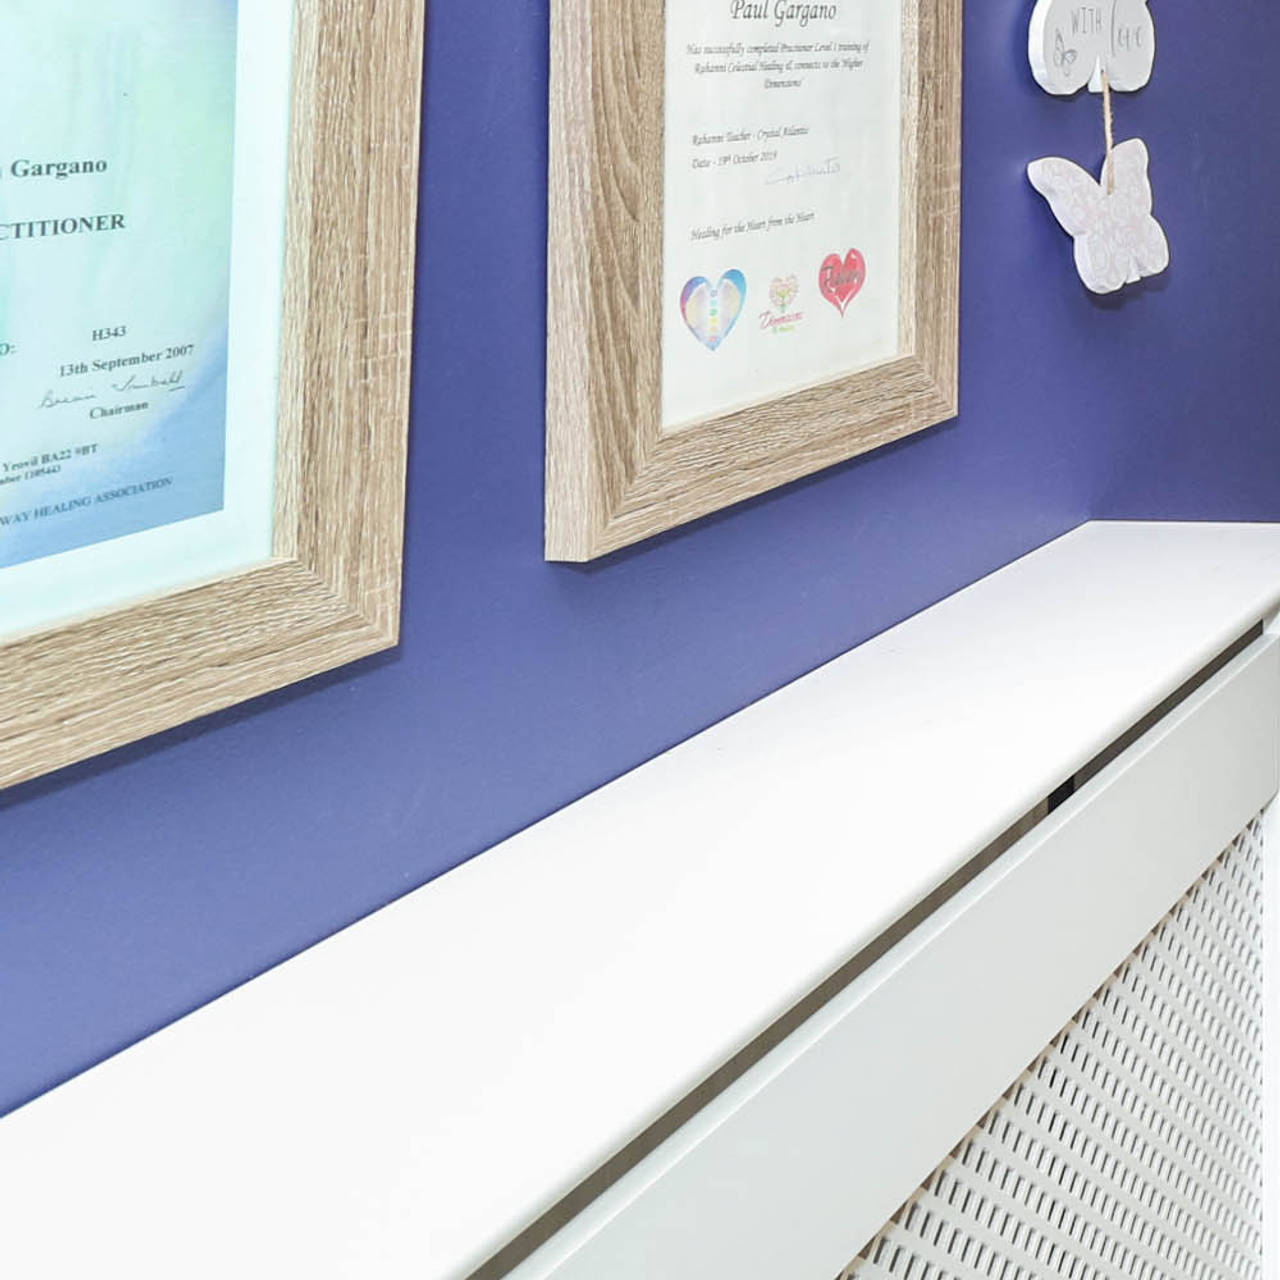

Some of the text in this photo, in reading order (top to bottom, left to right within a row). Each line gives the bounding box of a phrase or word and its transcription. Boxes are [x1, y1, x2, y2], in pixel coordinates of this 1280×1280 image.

[1071, 6, 1103, 36] WITH
[11, 159, 107, 180] Gargano
[91, 325, 127, 341] H343
[59, 344, 195, 377] 13th September 2007
[89, 400, 149, 419] Chairman
[34, 495, 92, 519] HEALING
[94, 476, 174, 504] ASSOCIATION
